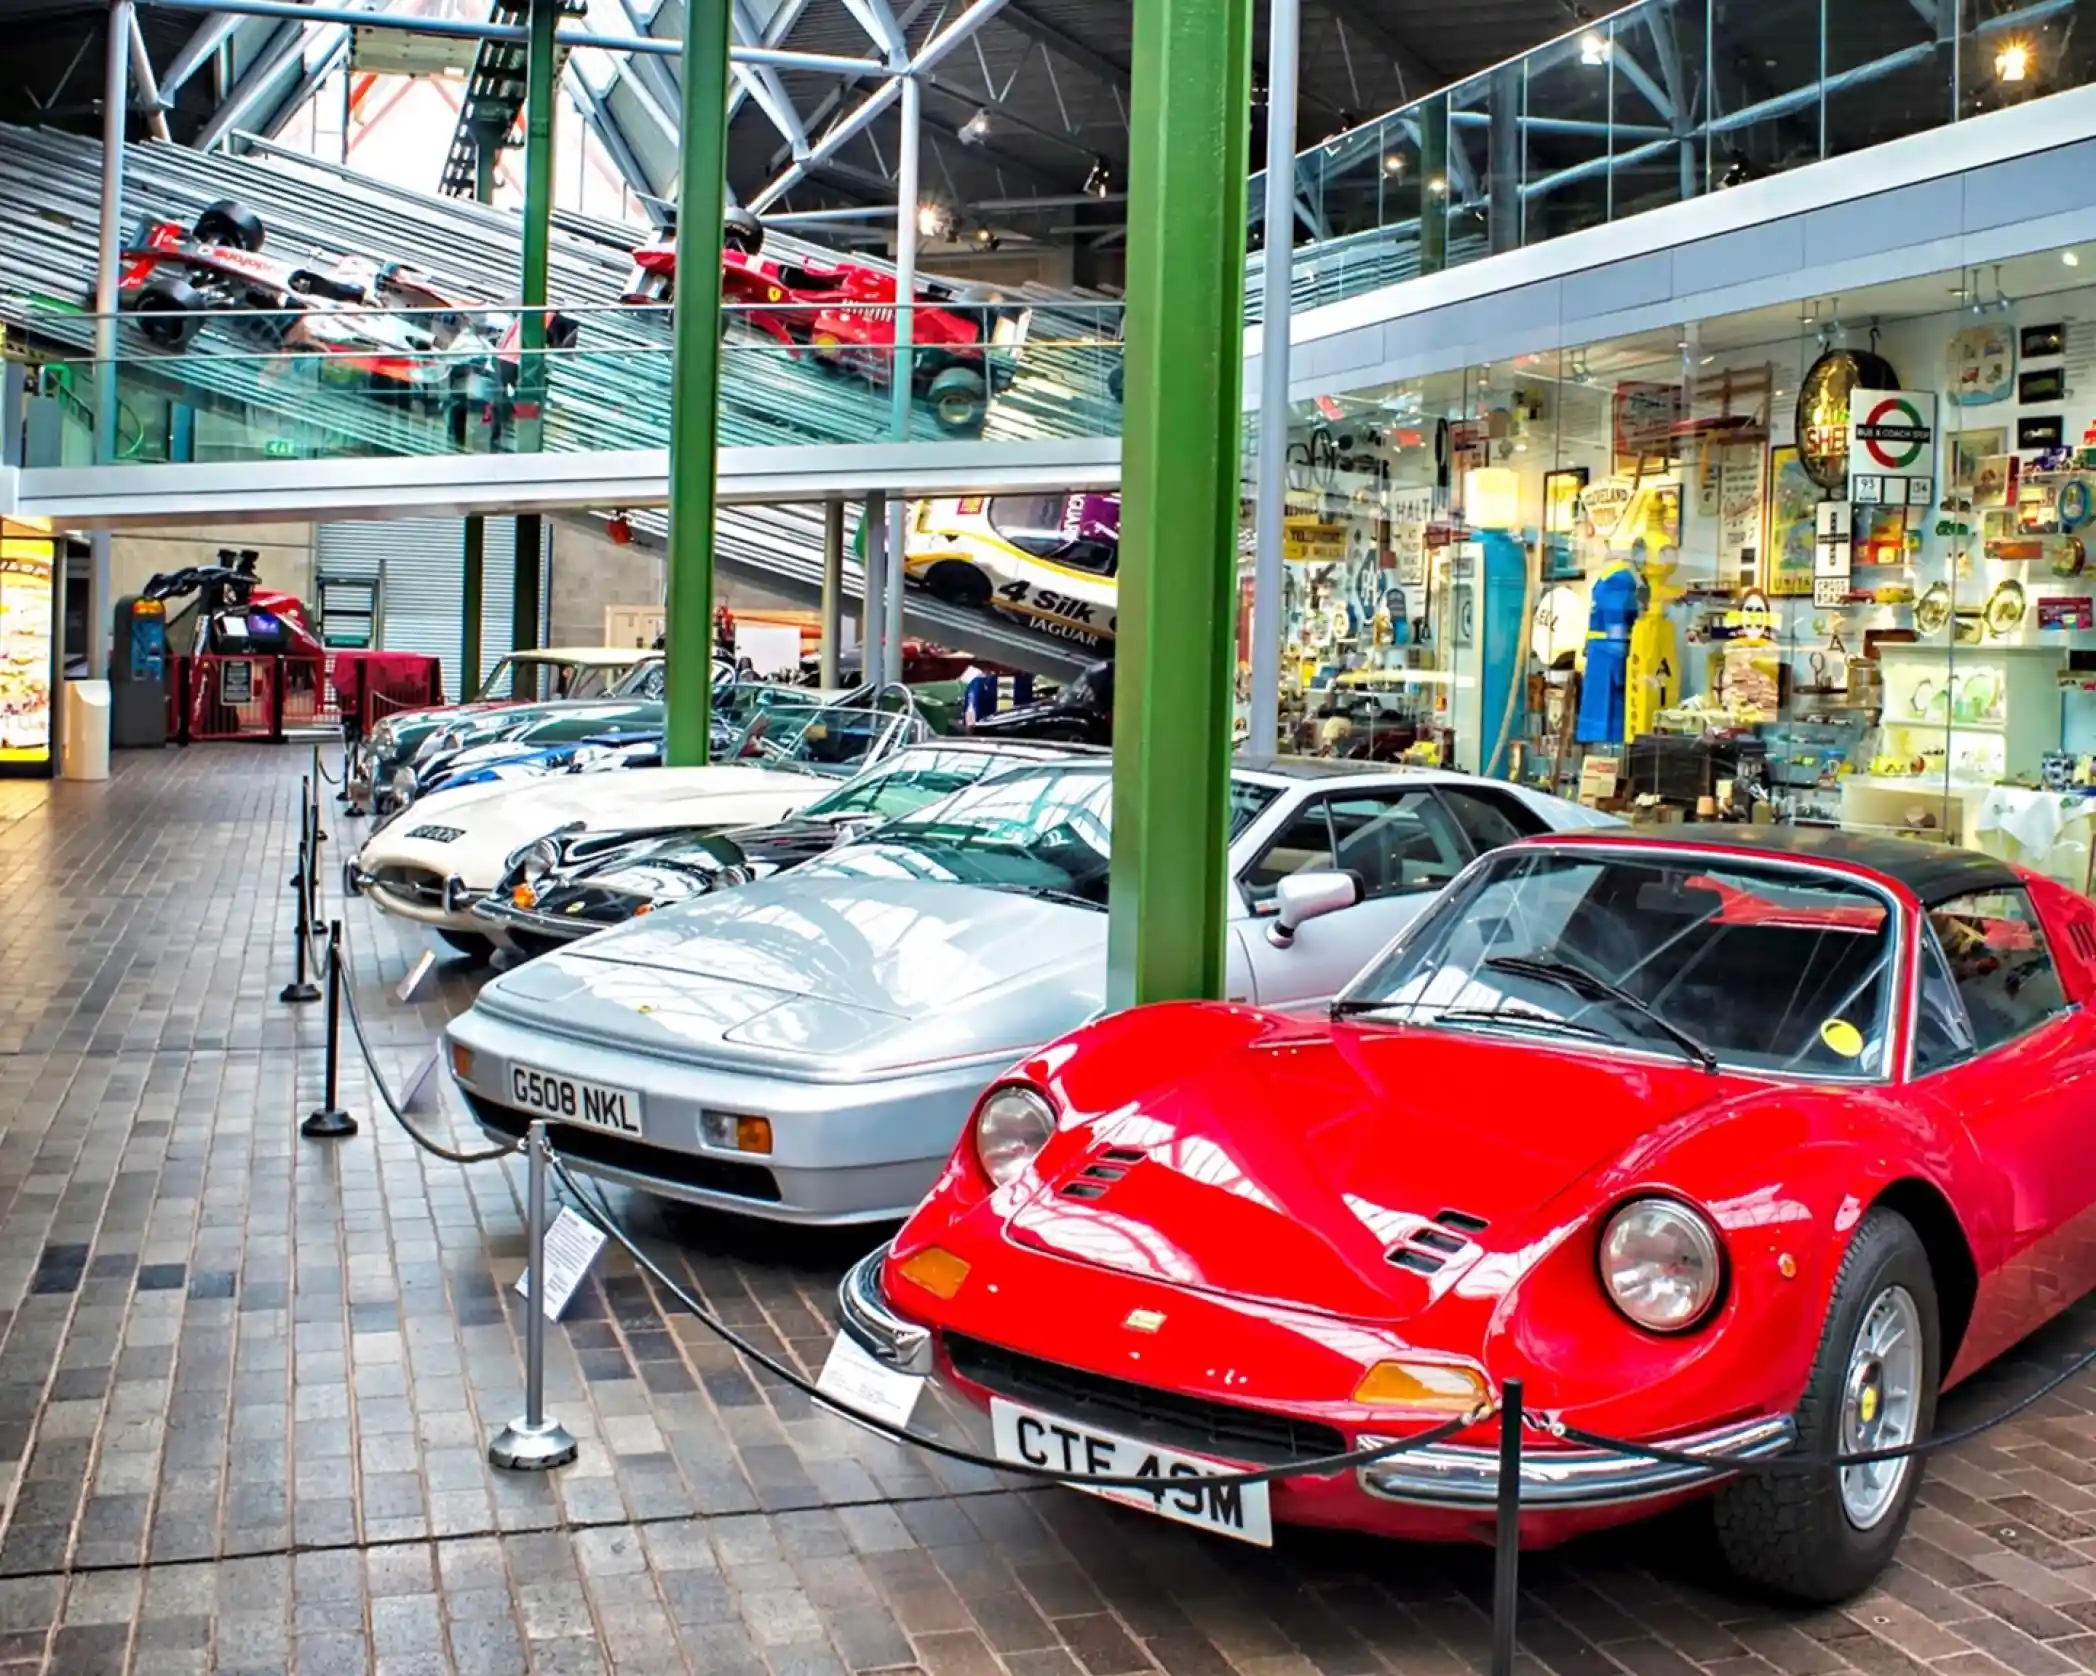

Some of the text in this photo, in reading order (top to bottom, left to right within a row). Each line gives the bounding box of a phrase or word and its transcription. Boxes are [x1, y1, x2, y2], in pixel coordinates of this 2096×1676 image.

[1807, 428, 1849, 454] SHEL
[1032, 589, 1097, 625] Silk
[1029, 615, 1099, 647] JAGUAR
[513, 1067, 639, 1132] G508 NKL
